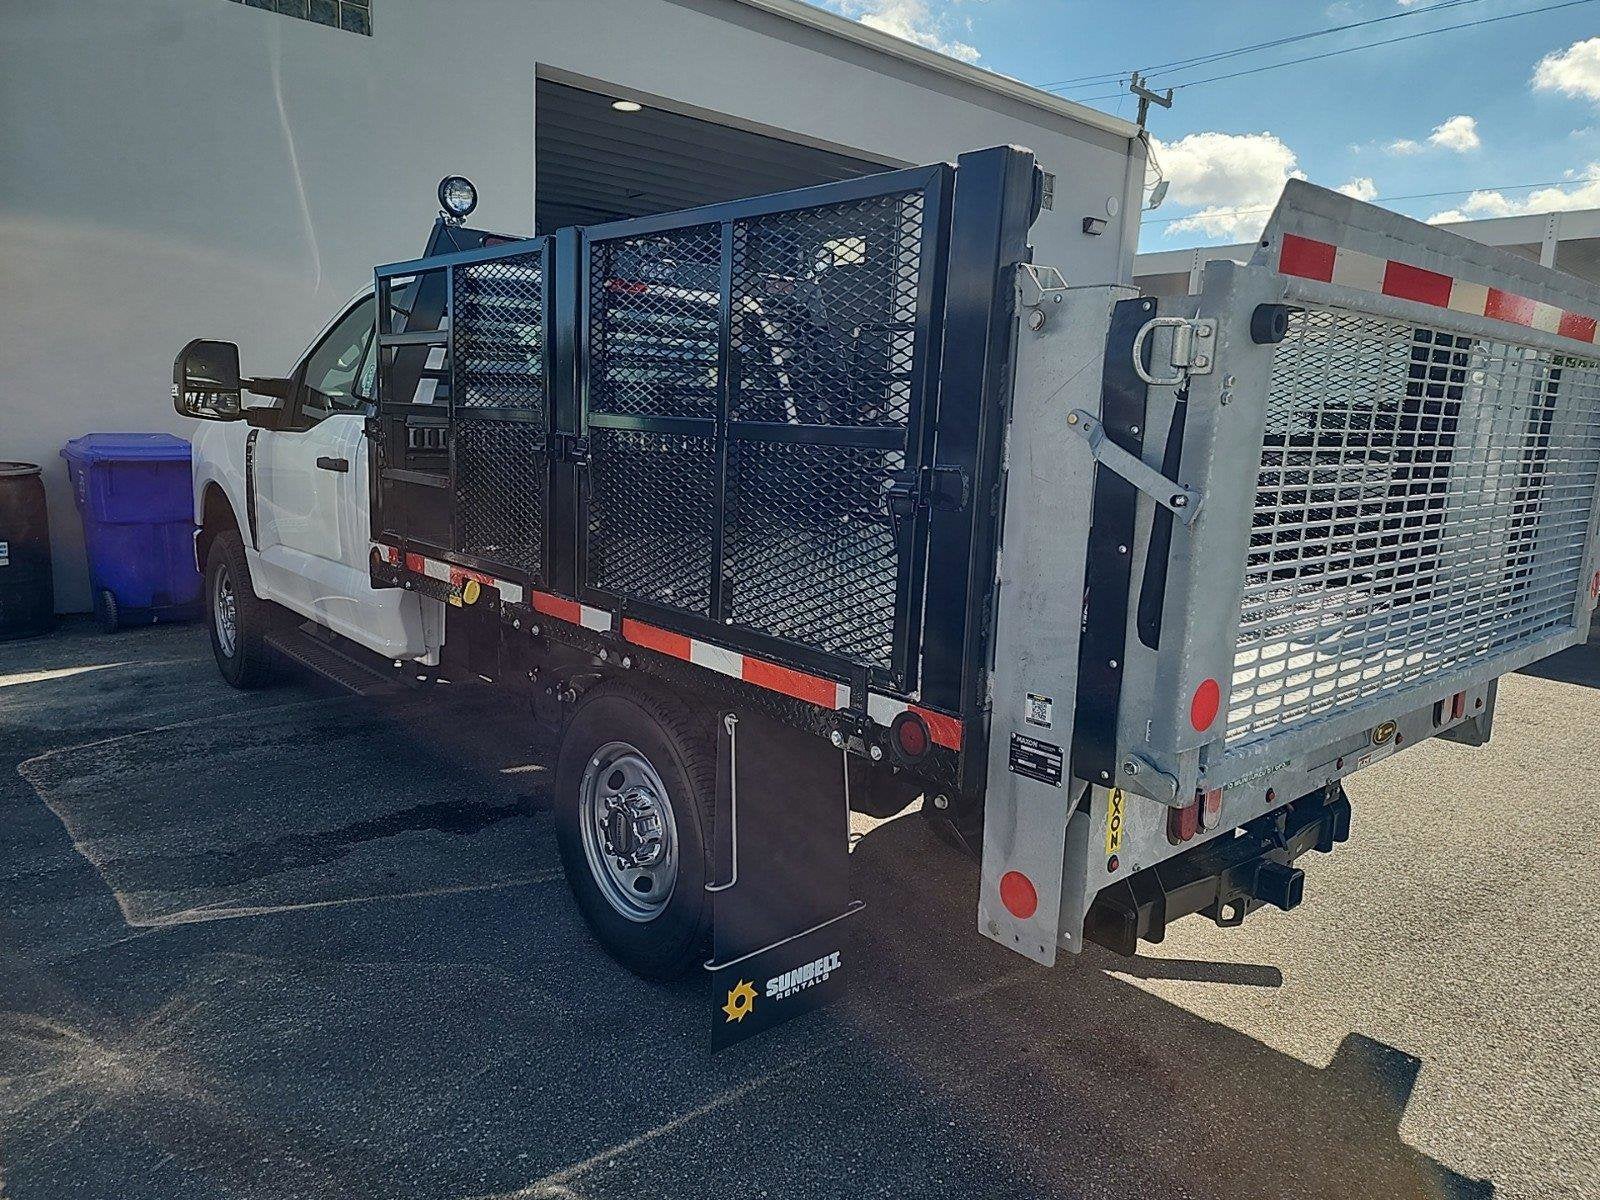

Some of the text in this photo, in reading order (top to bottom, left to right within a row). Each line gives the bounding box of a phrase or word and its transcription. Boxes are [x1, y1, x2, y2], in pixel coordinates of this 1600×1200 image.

[1111, 788, 1122, 847] AXON
[765, 952, 841, 998] SUNBELT
[776, 973, 830, 1001] RENTALS
